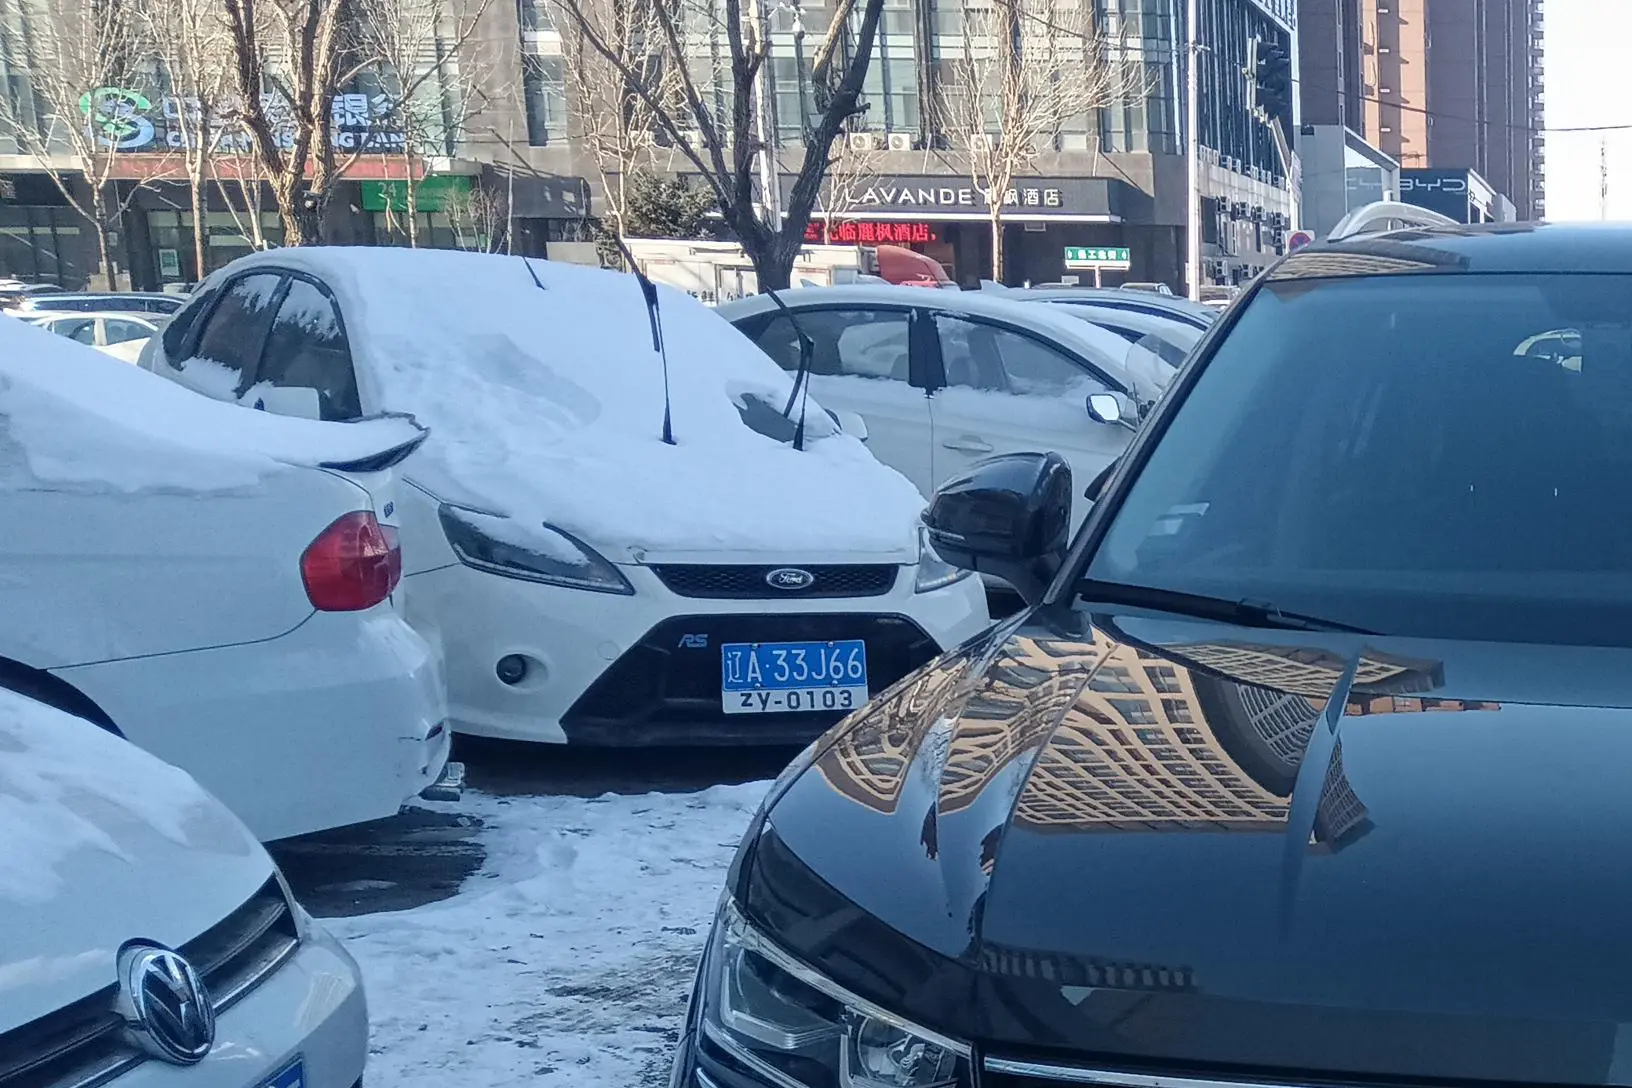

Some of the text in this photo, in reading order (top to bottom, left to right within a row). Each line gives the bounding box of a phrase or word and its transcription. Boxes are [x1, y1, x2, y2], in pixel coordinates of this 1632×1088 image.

[1400, 178, 1466, 191] BYD
[845, 187, 1060, 206] LAVANDE 枫酒店
[778, 571, 804, 584] Ford
[678, 633, 708, 648] RS
